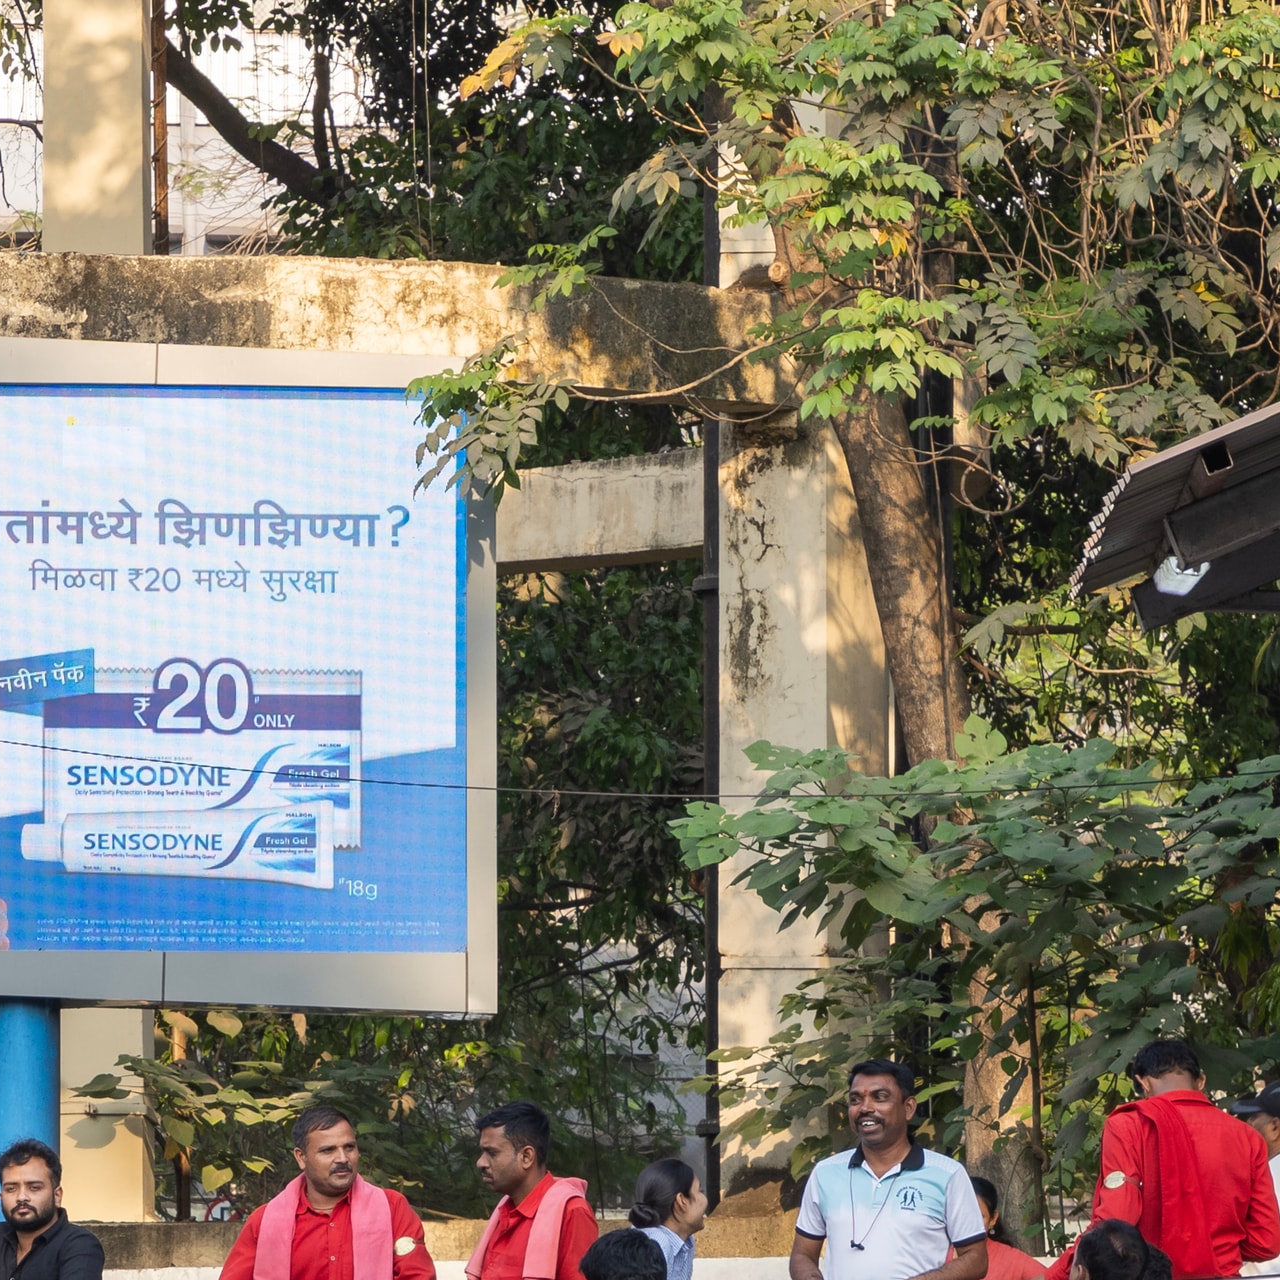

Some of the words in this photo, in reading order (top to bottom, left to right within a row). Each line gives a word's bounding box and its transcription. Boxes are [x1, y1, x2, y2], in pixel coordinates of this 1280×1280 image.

[155, 498, 411, 549] झिणझिण्या?
[30, 559, 118, 592] मिळवा
[128, 567, 181, 593] ₹20
[195, 561, 250, 593] मध्ये
[262, 568, 338, 602] सुरक्षा
[51, 662, 85, 685] पॅक
[253, 713, 296, 728] ONLY
[67, 764, 231, 787] SENSODYNE
[288, 768, 318, 779] Fresh
[320, 768, 340, 779] Gel
[84, 833, 223, 851] SENSODYNE
[265, 837, 290, 845] Fresh
[292, 837, 308, 845] Gel
